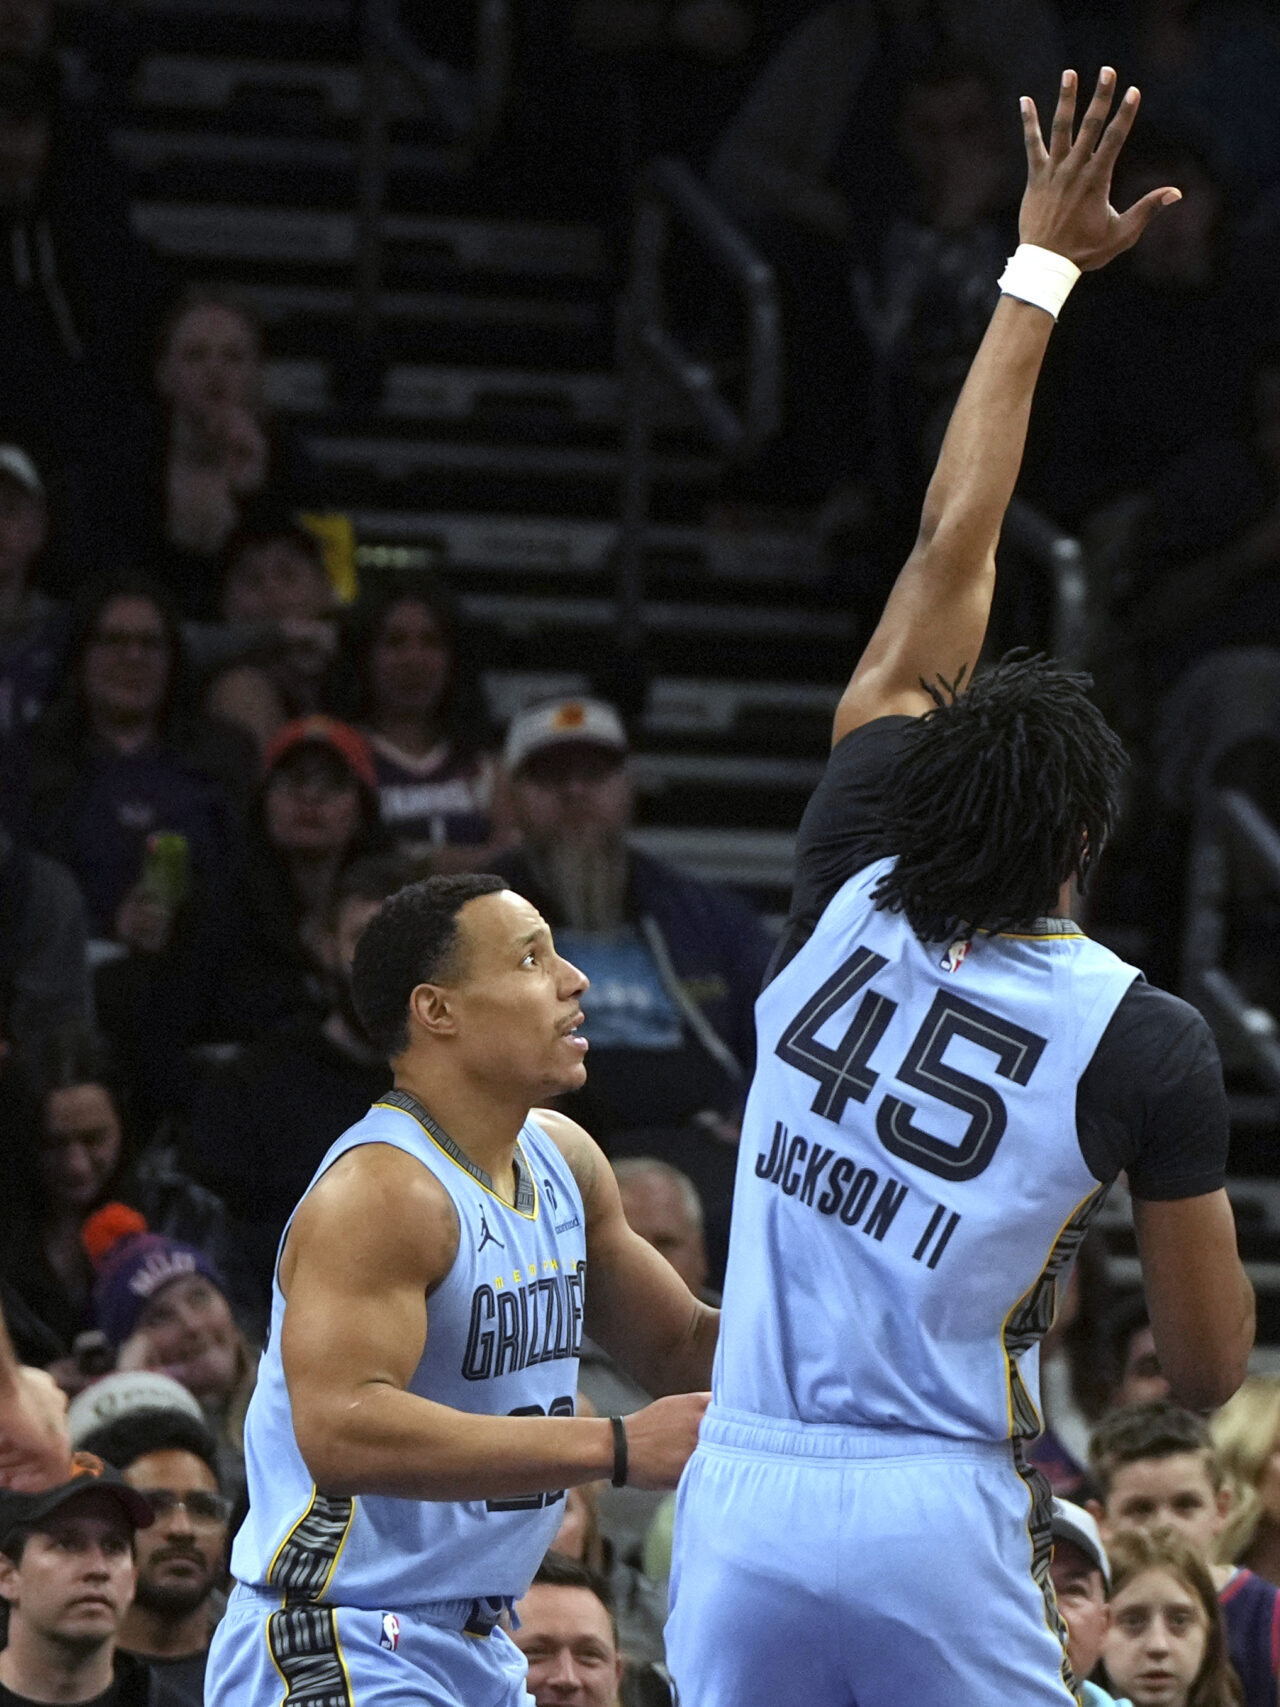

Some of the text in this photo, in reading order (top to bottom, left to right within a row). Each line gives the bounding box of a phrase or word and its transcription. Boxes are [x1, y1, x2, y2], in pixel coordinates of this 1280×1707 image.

[775, 945, 1048, 1182] 45
[911, 1203, 962, 1270] II
[494, 1258, 577, 1291] MEMPH
